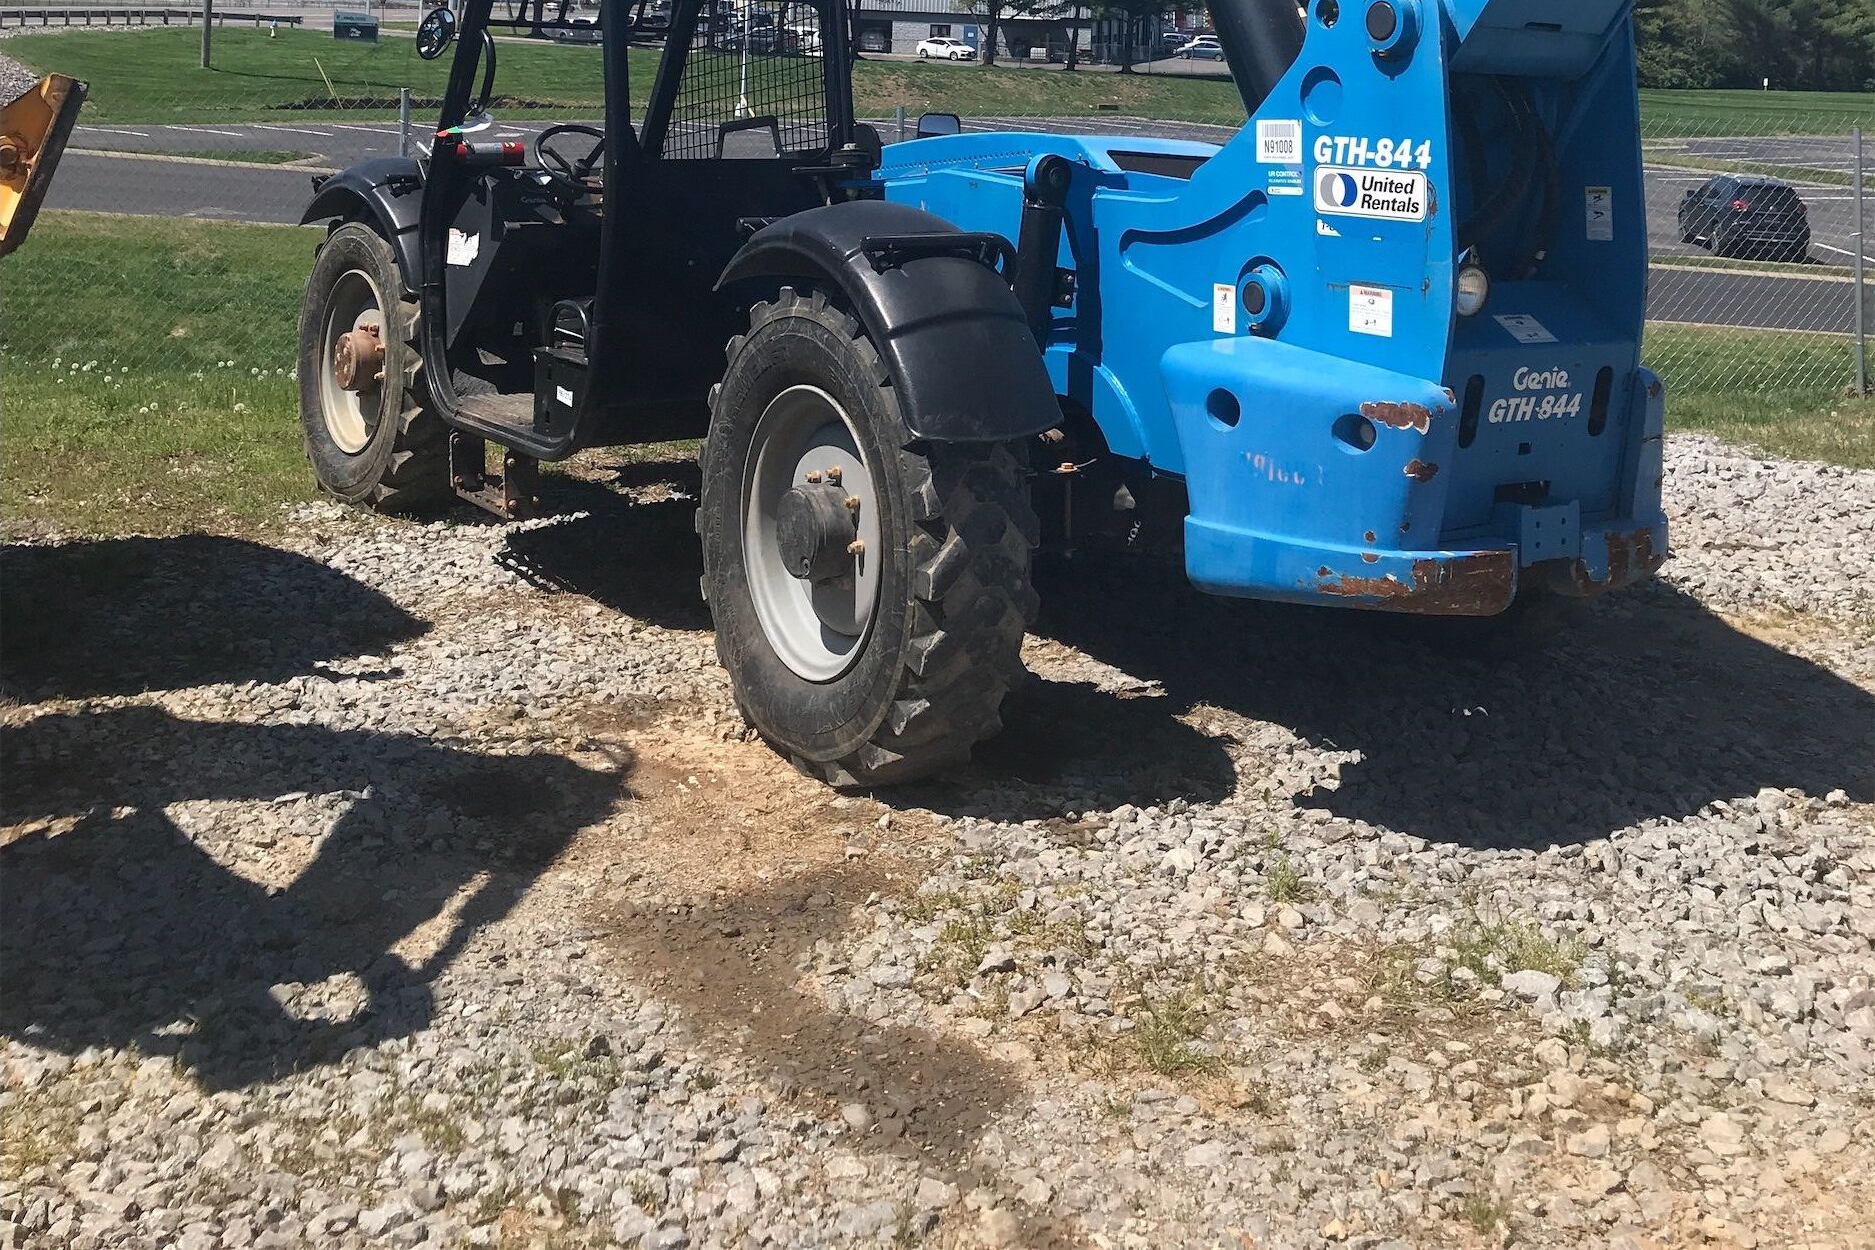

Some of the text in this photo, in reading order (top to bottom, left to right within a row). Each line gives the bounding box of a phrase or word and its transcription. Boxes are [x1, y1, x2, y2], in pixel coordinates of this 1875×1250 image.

[1264, 139, 1294, 154] N91008
[1313, 135, 1432, 170] GTH-844
[1361, 175, 1415, 195] United
[1360, 194, 1420, 214] Rentals
[1513, 365, 1570, 391] Genie
[1488, 392, 1584, 424] GTH-844
